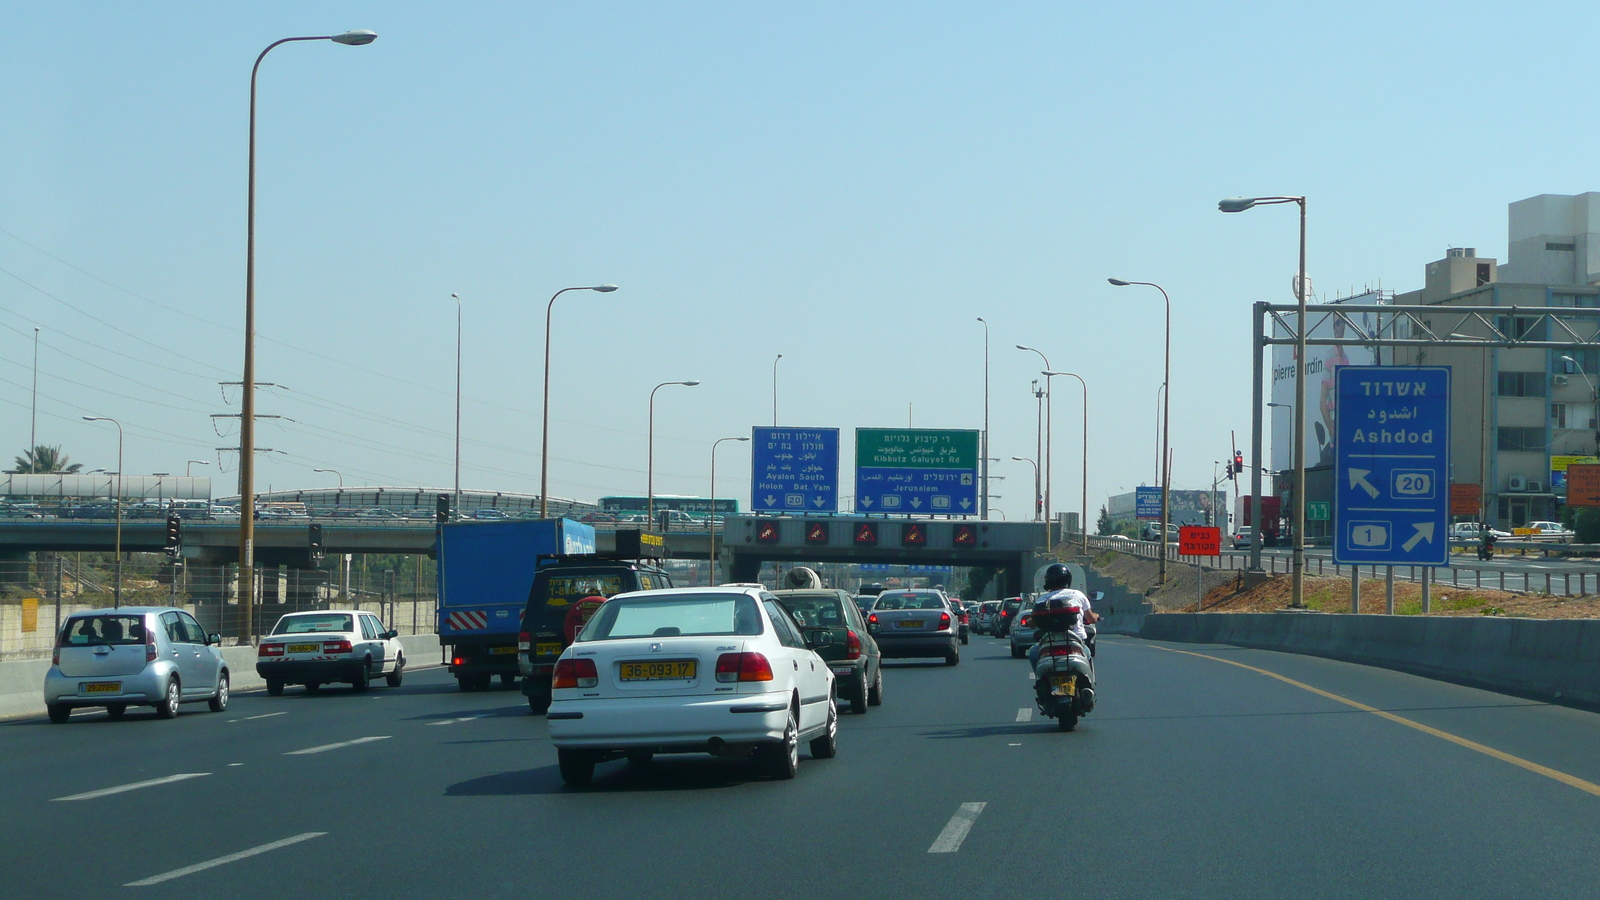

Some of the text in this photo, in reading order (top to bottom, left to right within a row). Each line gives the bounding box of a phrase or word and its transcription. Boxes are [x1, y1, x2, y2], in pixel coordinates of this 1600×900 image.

[1274, 357, 1323, 385] pierre rdin
[1360, 381, 1426, 397] אשדוד
[771, 432, 821, 441] איילון דרום
[884, 434, 910, 443] גלויות
[914, 435, 938, 444] קיבוץ
[1352, 428, 1433, 443] Ashdod
[768, 442, 824, 451] חולון בת ים
[873, 455, 907, 463] Kibbutz
[911, 455, 944, 464] Galuyot
[766, 472, 825, 481] Ayalon South
[923, 473, 958, 481] ירושלים
[759, 482, 783, 490] Holon
[793, 483, 808, 491] Bat
[893, 484, 939, 492] Jerusalem
[1402, 477, 1424, 491] 20
[788, 496, 801, 504] 20
[1364, 529, 1372, 542] 1
[1184, 542, 1215, 551] מקורצף
